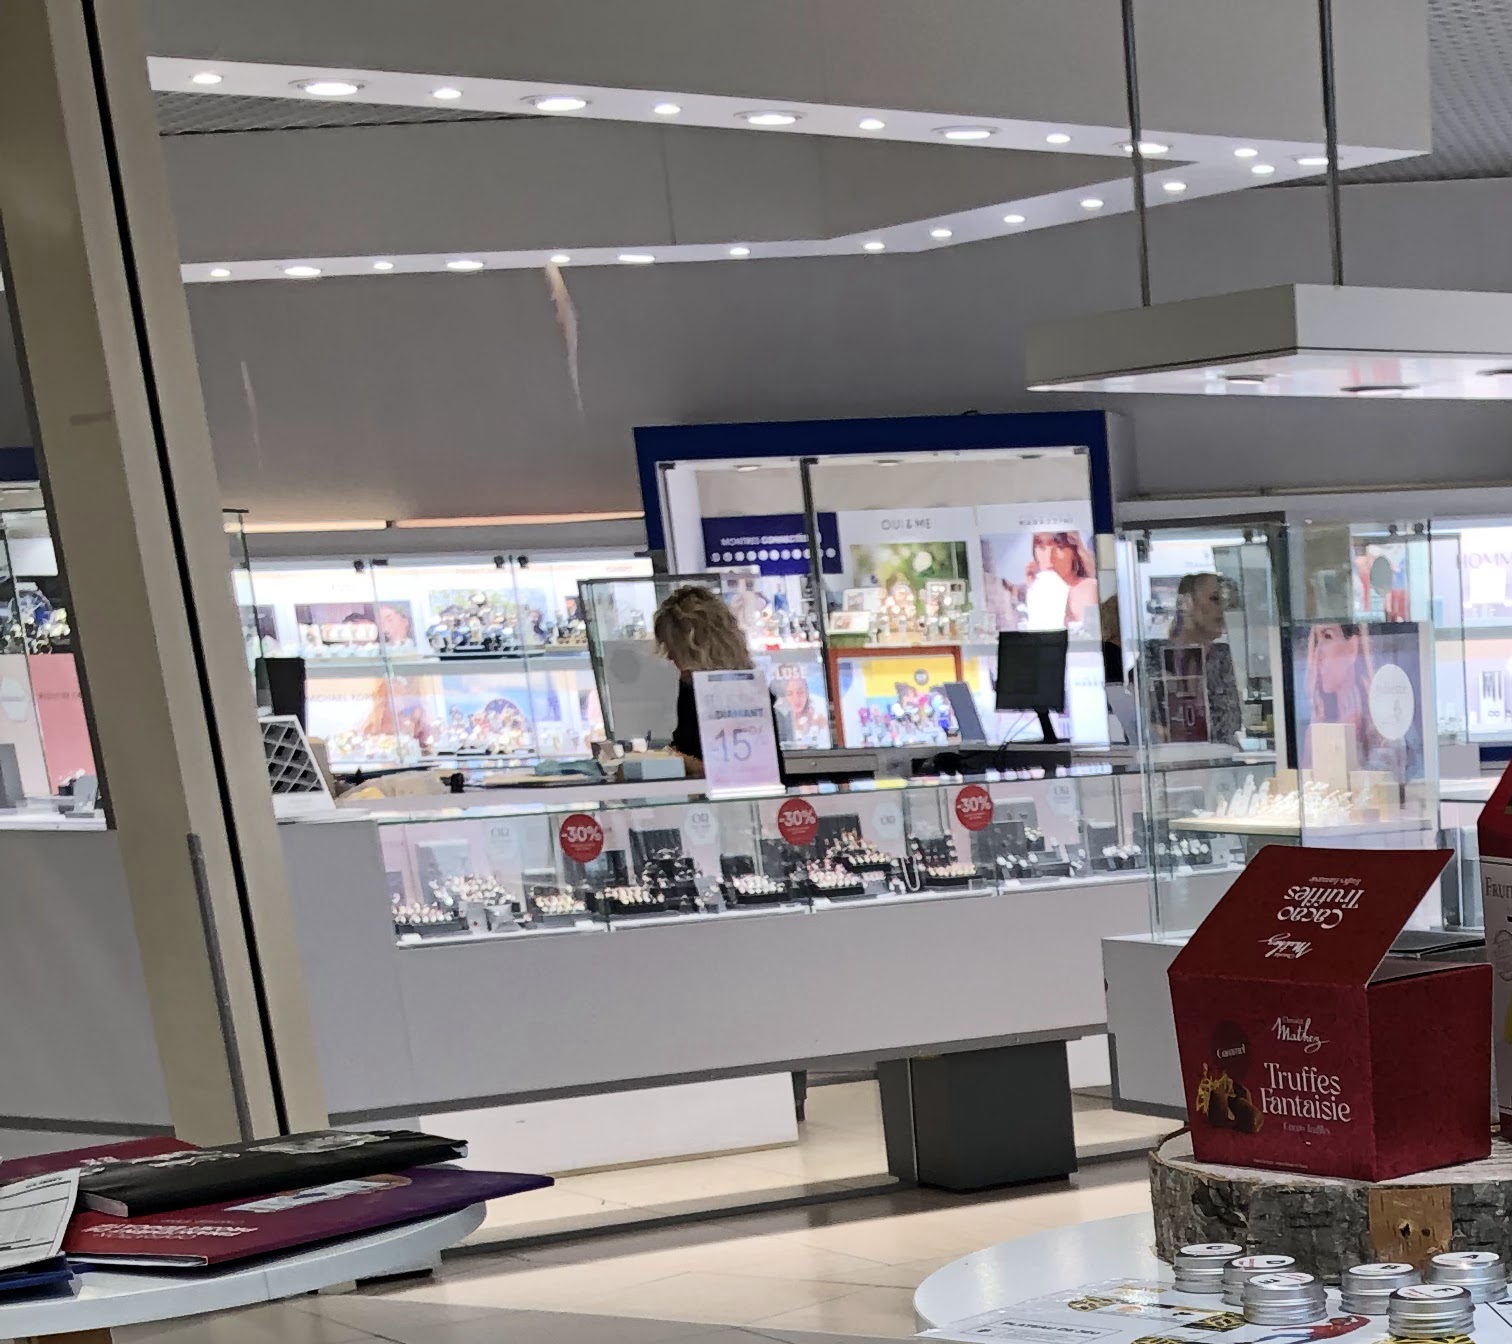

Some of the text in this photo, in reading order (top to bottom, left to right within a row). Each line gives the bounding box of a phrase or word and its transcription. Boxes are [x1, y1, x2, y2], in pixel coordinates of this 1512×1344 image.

[957, 797, 992, 813] -30%
[778, 811, 817, 827] -30%
[561, 826, 602, 843] -30%
[1284, 886, 1365, 908] Truffles
[1277, 906, 1343, 929] Cacao
[1271, 1017, 1330, 1054] Mathez
[1263, 1062, 1342, 1095] Truffes
[1260, 1087, 1351, 1123] Fantaisie
